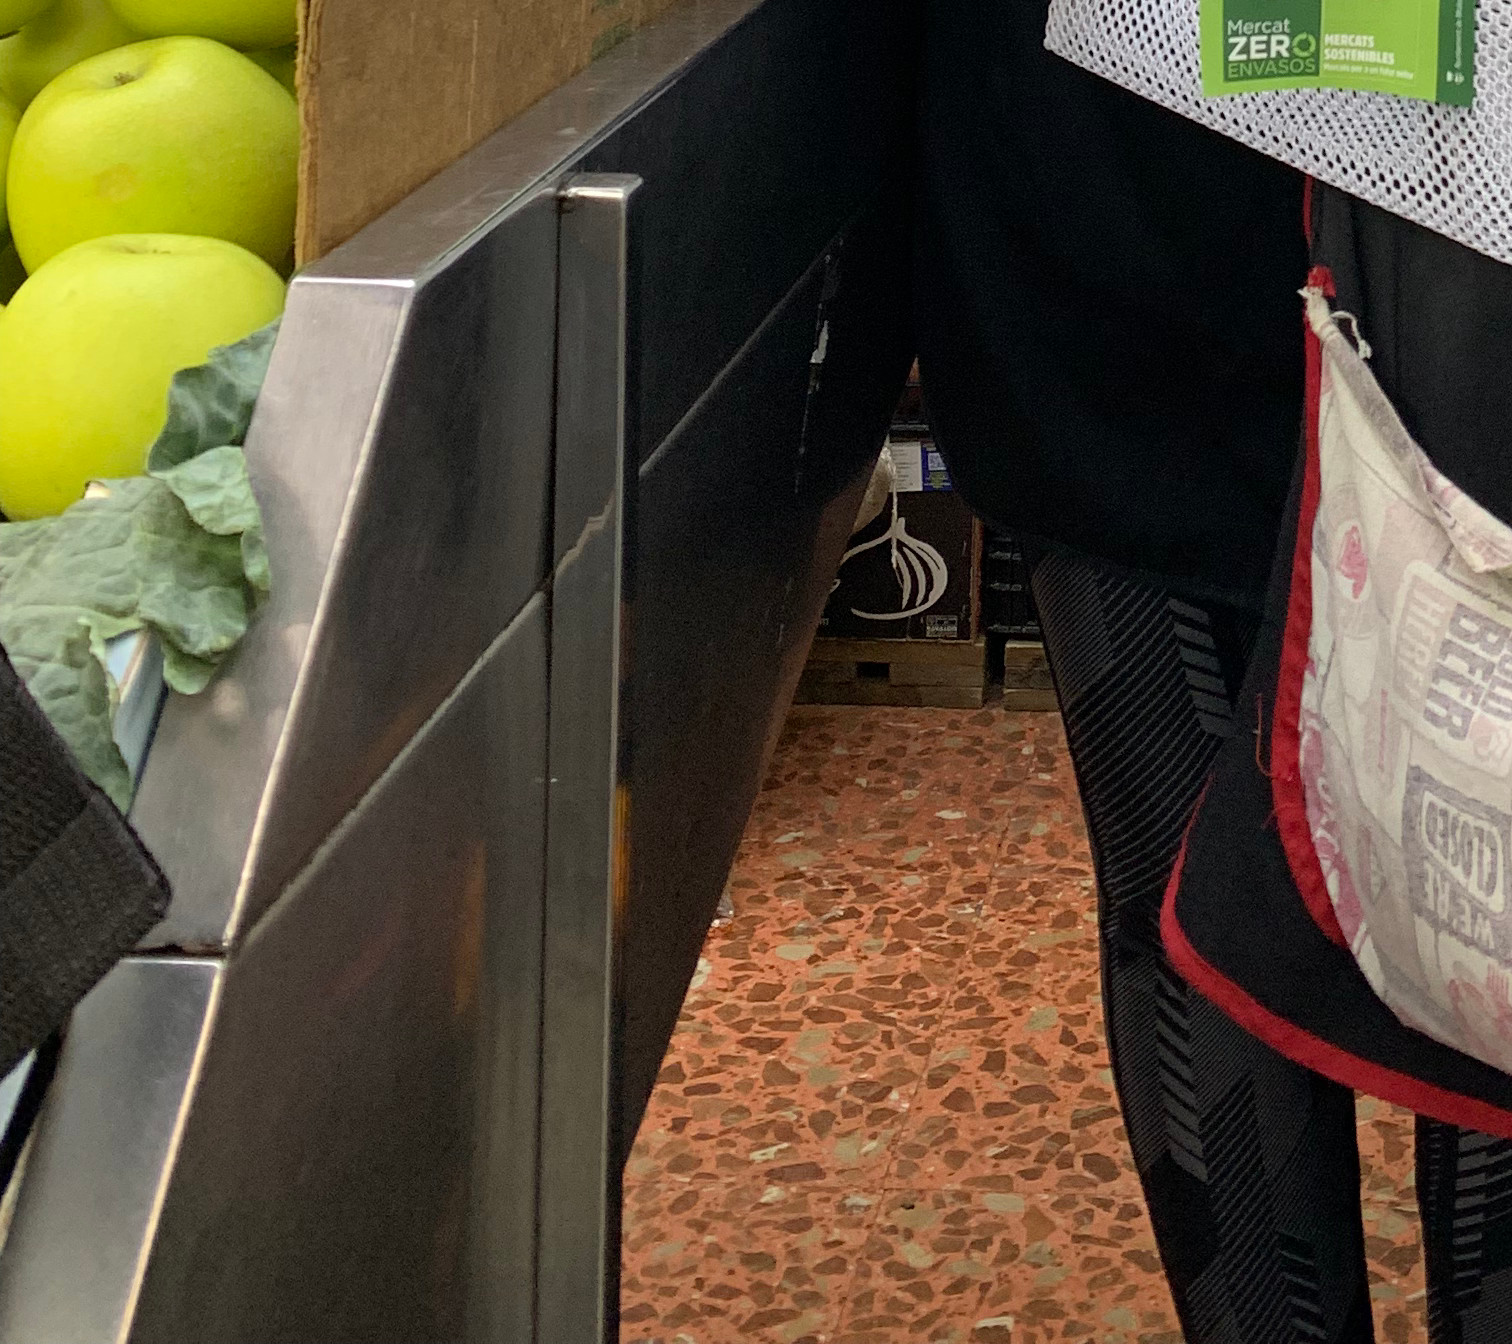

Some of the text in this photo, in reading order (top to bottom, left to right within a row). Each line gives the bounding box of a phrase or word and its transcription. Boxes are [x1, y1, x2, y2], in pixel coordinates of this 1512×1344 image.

[1227, 17, 1291, 36] Mercat
[1227, 32, 1317, 62] ZERO
[1324, 33, 1375, 49] MERCATS
[1227, 58, 1317, 79] ENVASOS
[1323, 47, 1395, 66] SOSTENIBLES
[1424, 603, 1512, 743] BEER
[1426, 796, 1499, 900] CLOSED
[1418, 874, 1495, 952] WE'RE
